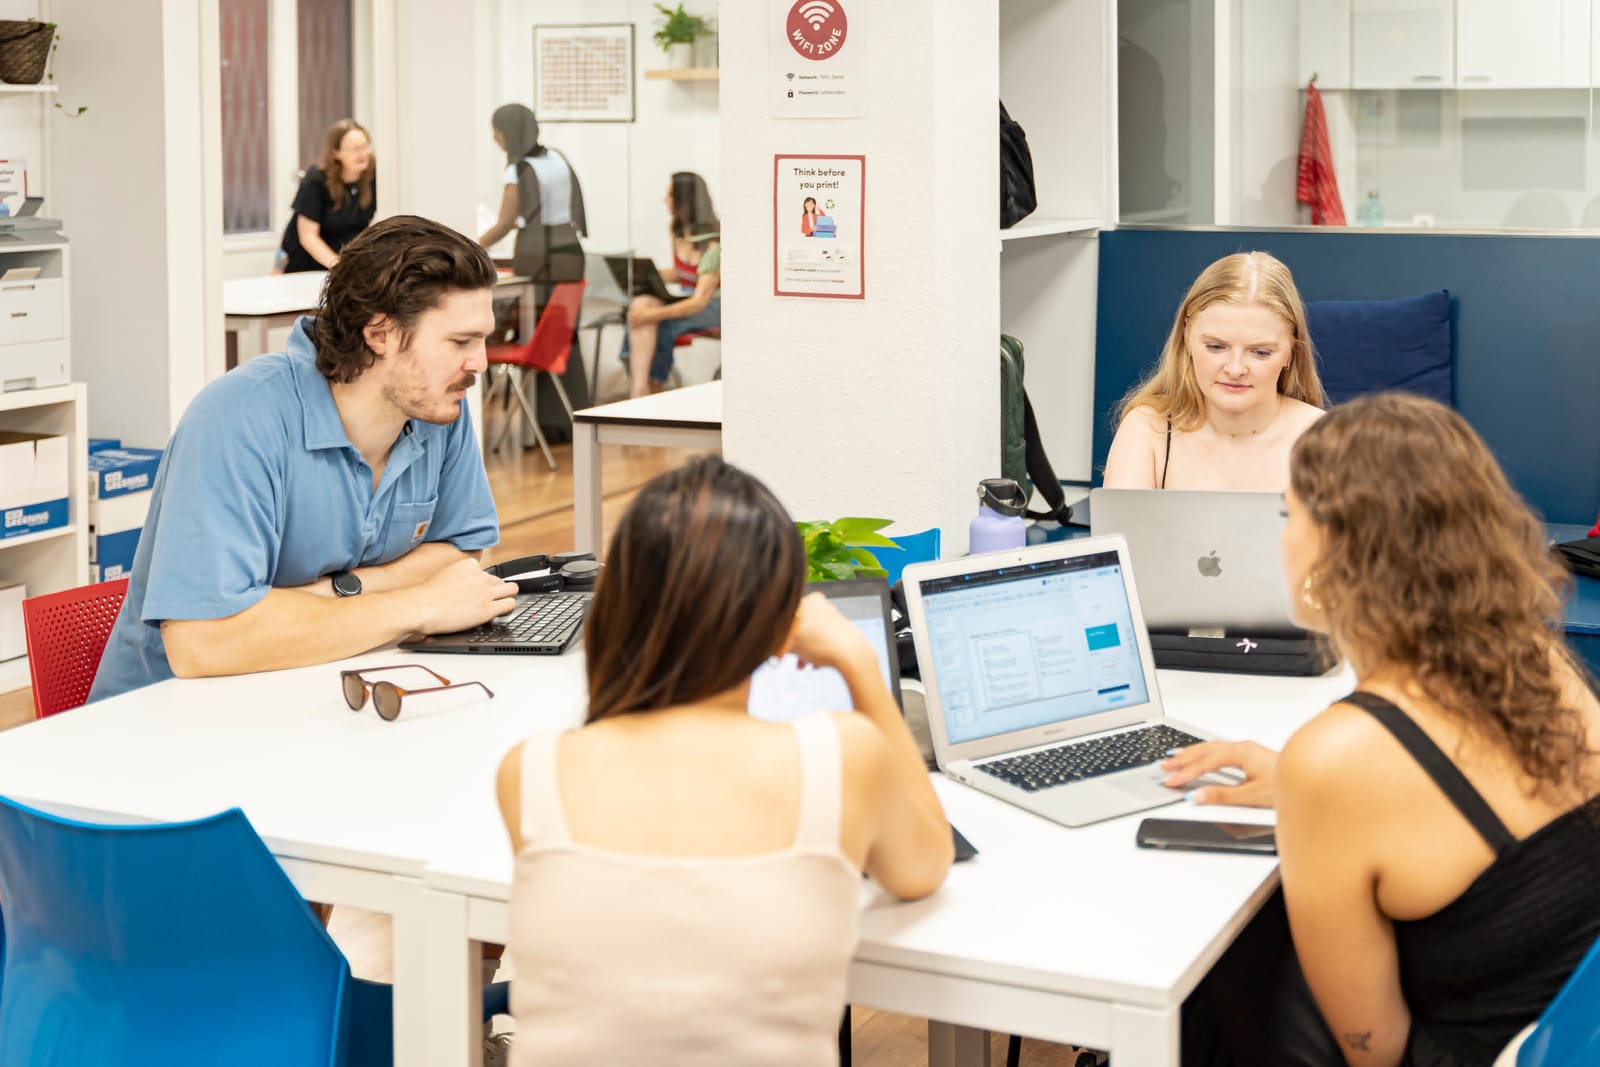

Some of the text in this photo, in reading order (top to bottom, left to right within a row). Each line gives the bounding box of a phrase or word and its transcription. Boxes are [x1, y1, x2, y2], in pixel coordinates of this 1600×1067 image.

[792, 28, 842, 54] WIFI ZONE
[793, 168, 846, 177] Think before
[799, 181, 839, 190] you print!
